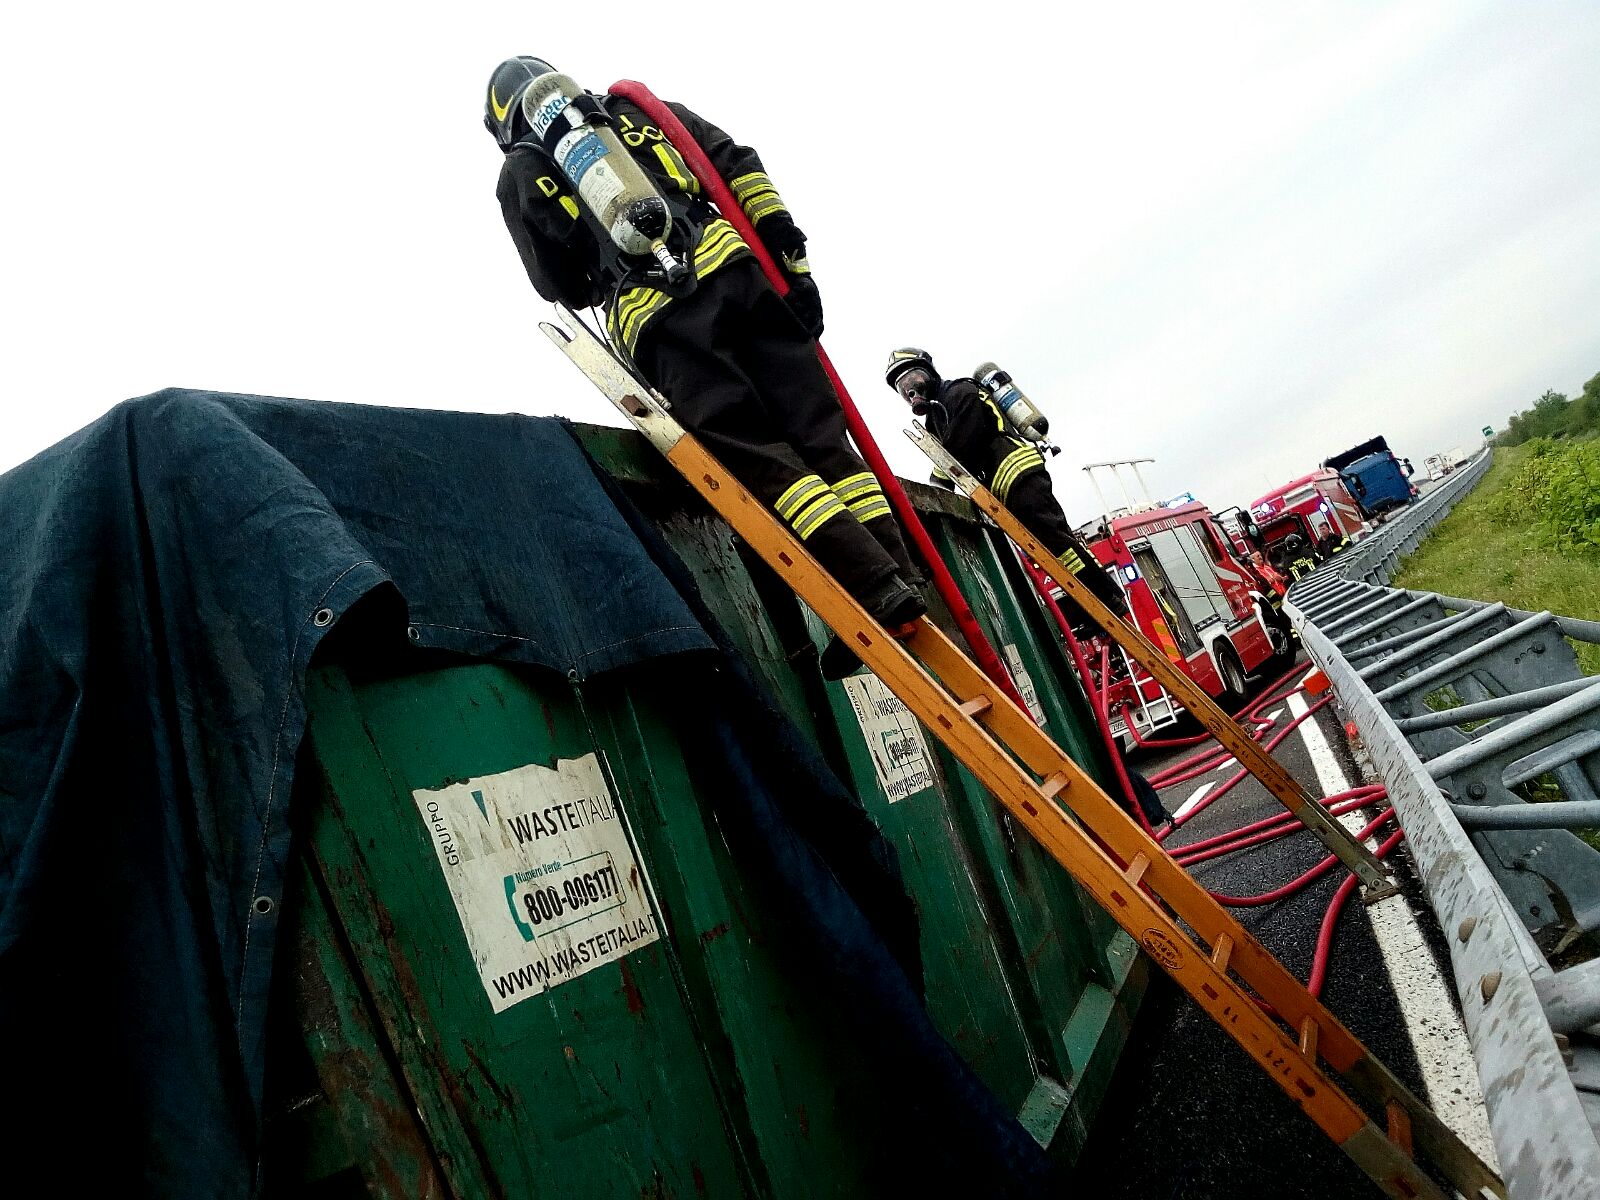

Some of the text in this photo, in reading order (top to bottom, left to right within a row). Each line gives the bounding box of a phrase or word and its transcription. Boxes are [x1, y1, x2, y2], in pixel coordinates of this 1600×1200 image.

[427, 801, 460, 867] GRUPPO
[523, 865, 620, 926] 800-006177
[491, 913, 656, 1000] WWW.WASTEITALIA.I
